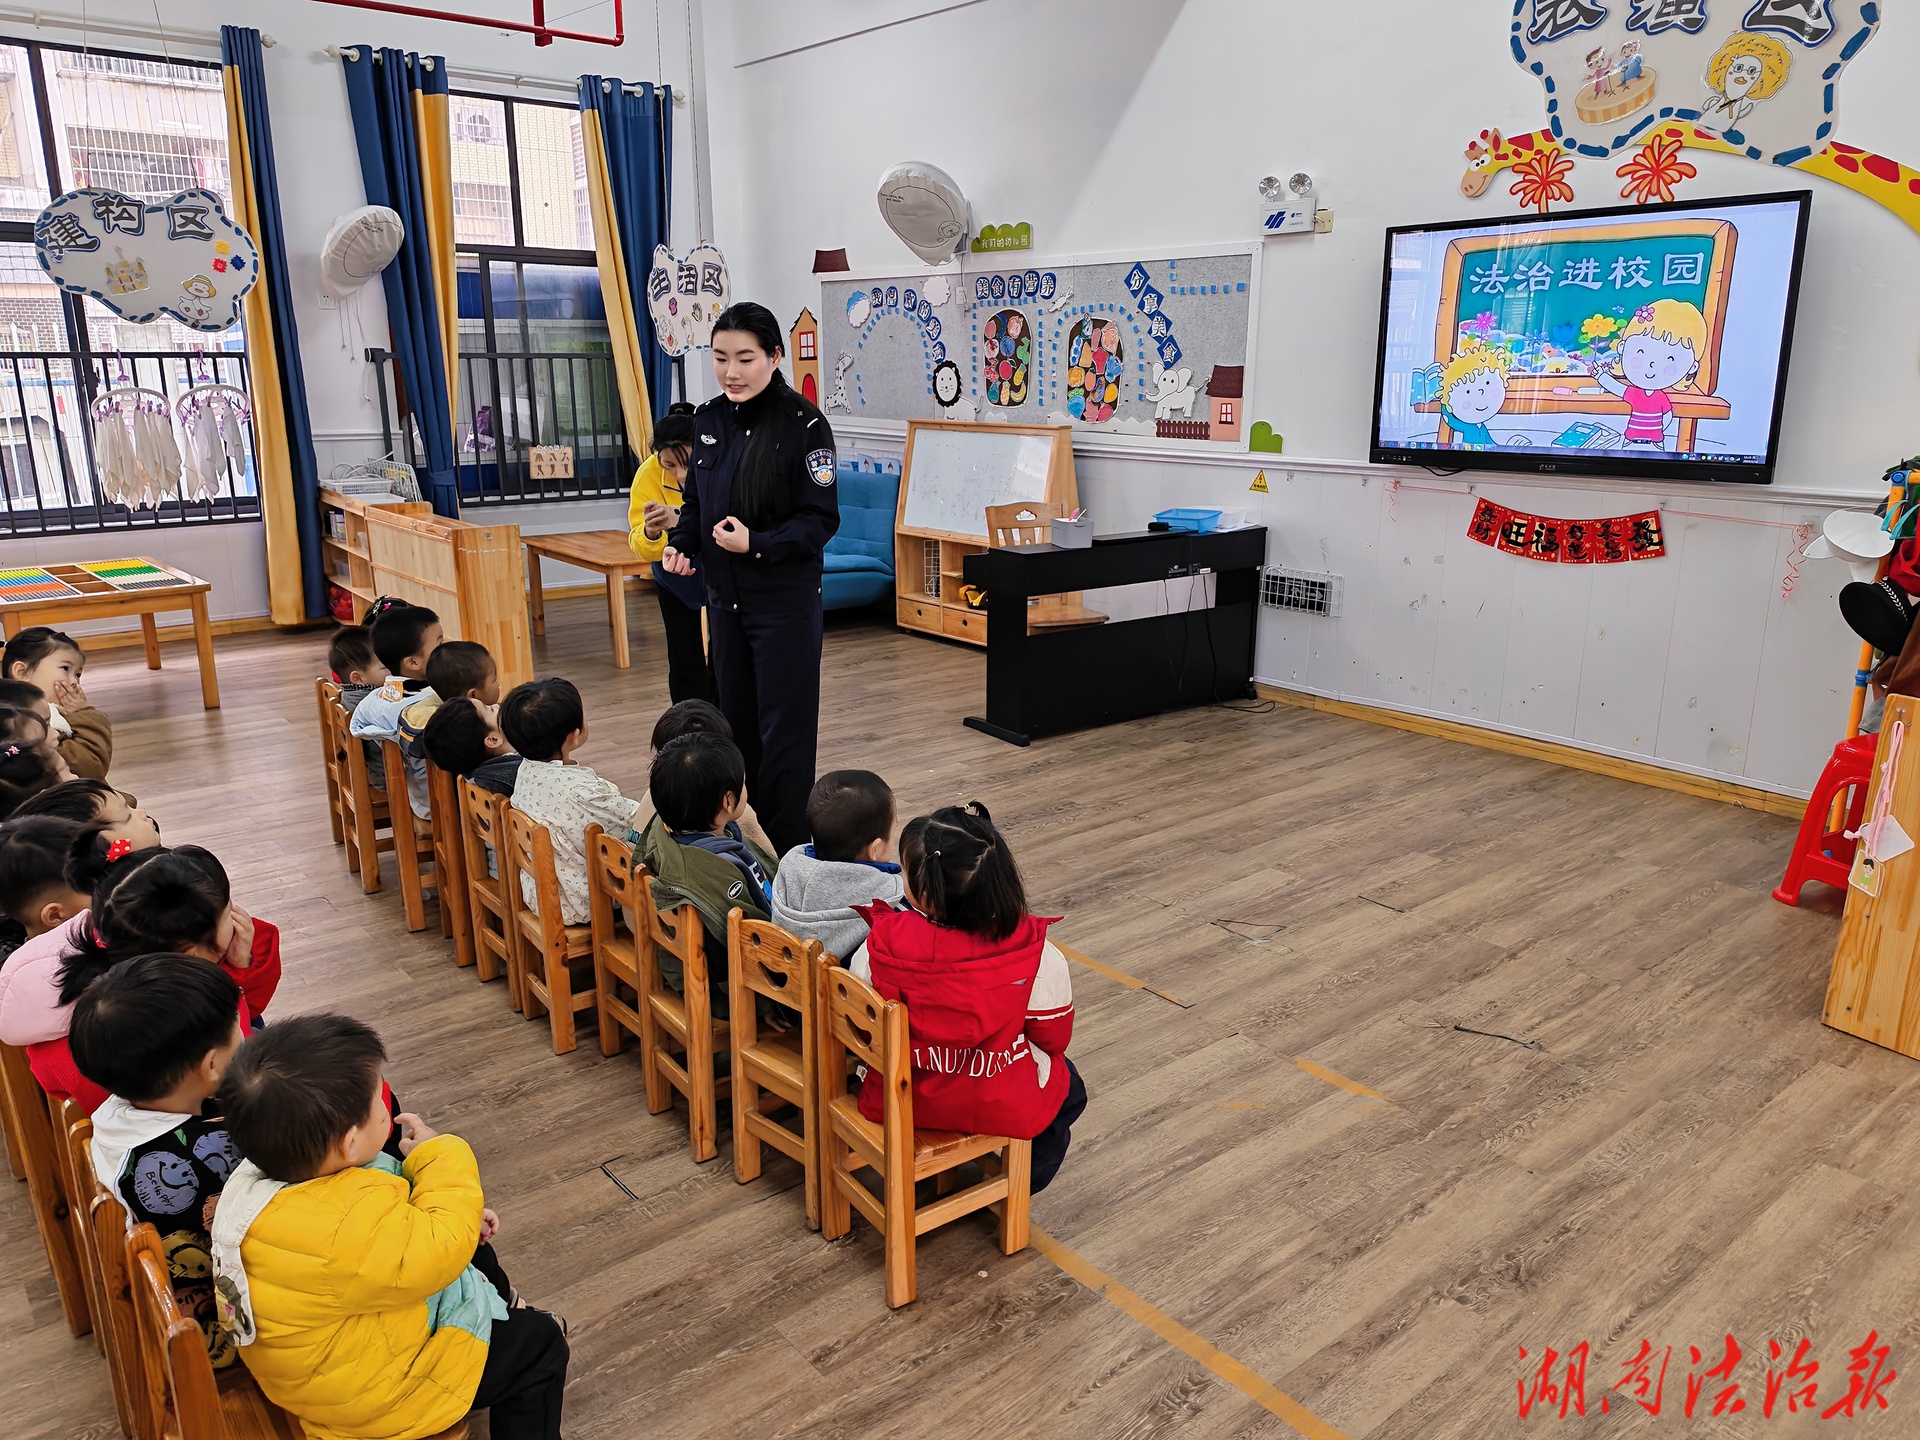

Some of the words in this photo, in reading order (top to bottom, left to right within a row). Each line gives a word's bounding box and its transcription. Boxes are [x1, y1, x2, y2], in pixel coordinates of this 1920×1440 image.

[36, 194, 216, 262] 建构区
[981, 234, 1028, 249] 我们的幼儿园
[649, 262, 723, 302] 生活区
[976, 272, 1055, 298] 美食有营养
[1468, 251, 1705, 294] 法治进校园
[1129, 268, 1178, 364] 分享美食
